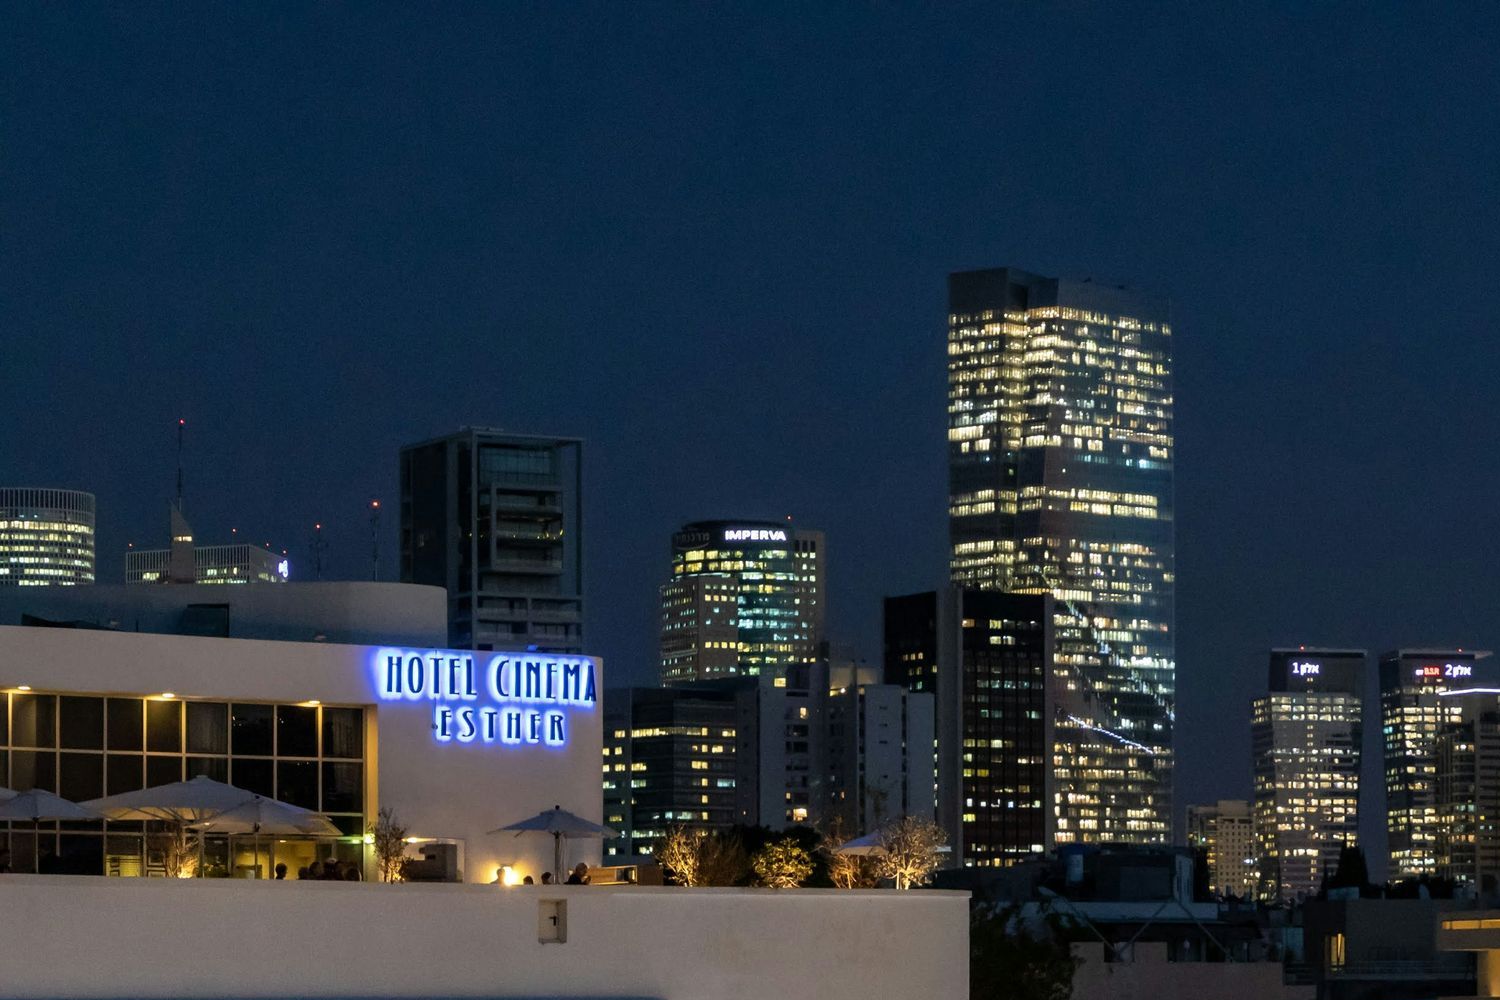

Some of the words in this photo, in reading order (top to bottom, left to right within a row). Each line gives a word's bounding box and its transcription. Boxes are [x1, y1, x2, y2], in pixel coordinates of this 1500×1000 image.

[725, 530, 786, 541] IMPERVA
[1292, 662, 1300, 674] 1
[1445, 663, 1453, 676] 2
[386, 655, 477, 696] HOTEL
[495, 659, 597, 702] CINEMA
[440, 709, 565, 742] ESTHER
